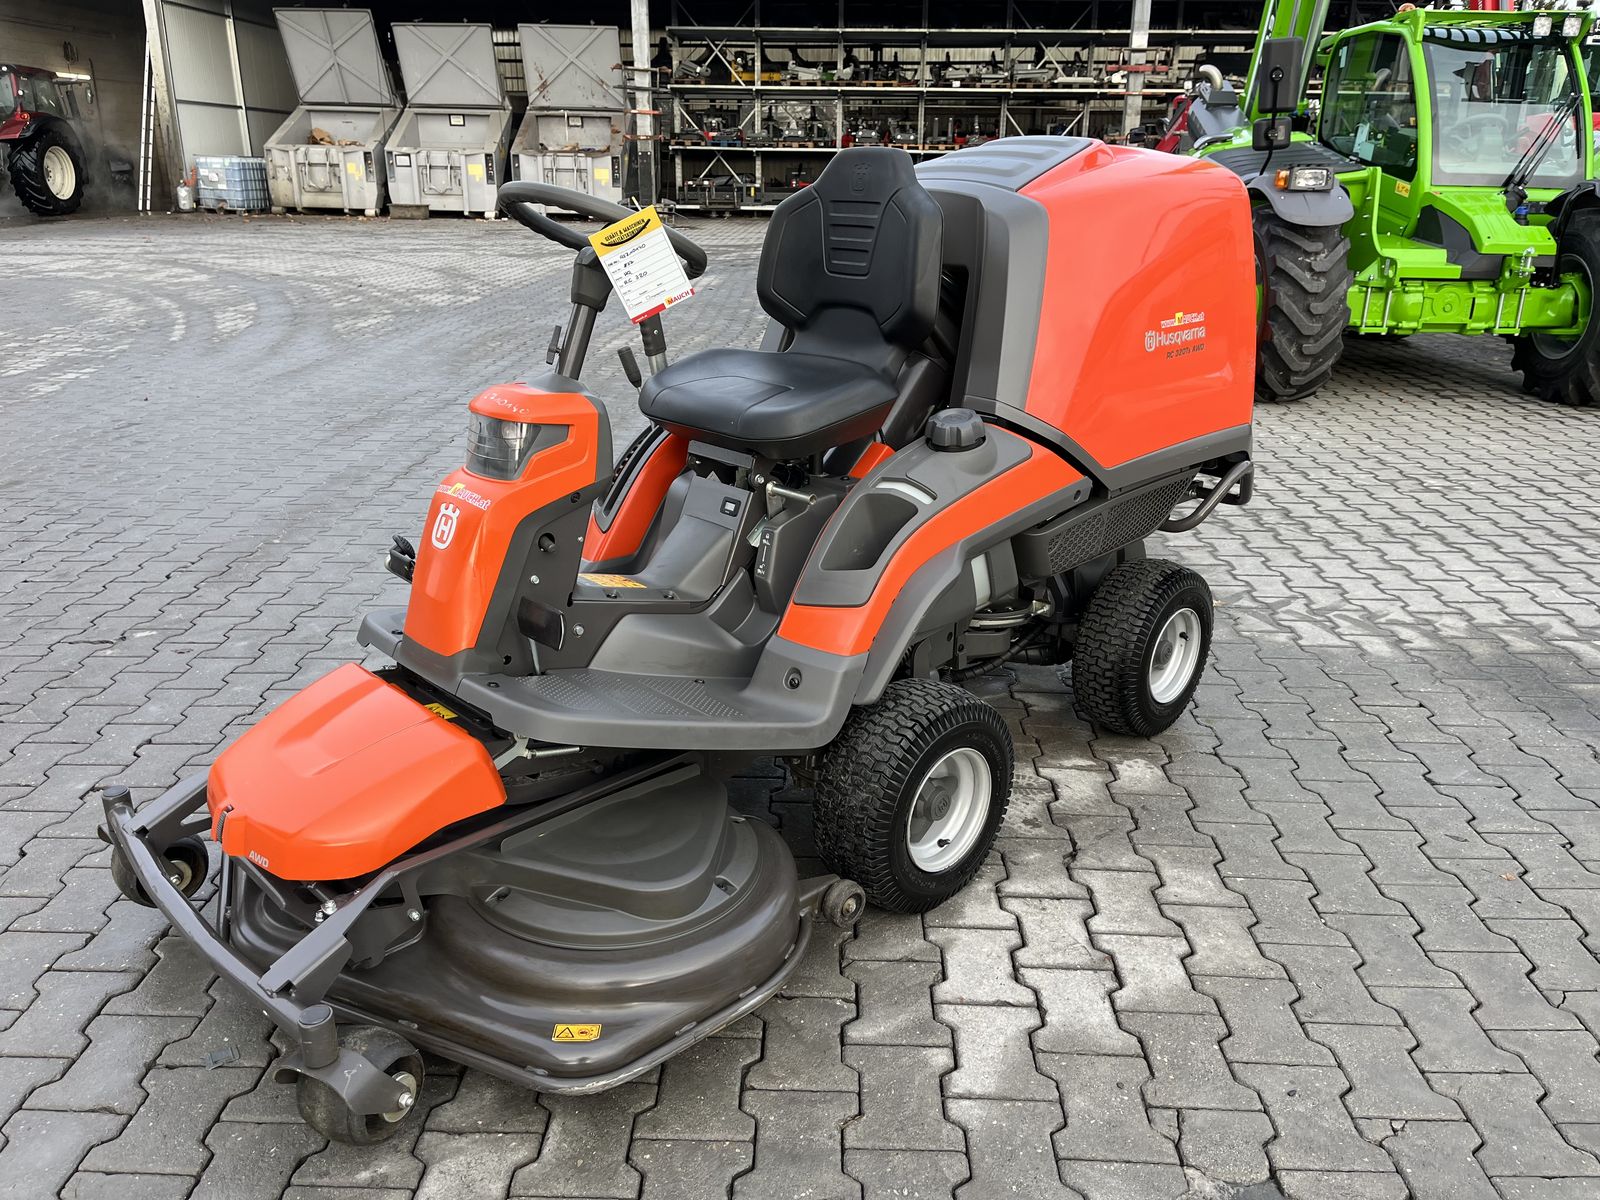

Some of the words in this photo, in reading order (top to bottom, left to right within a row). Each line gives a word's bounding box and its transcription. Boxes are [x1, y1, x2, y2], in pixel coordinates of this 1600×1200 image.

[623, 218, 646, 234] MASCHINEN
[635, 271, 648, 280] 320
[666, 290, 690, 305] MAUCH
[1156, 327, 1206, 347] Husqvarna
[1166, 350, 1175, 359] RC
[1192, 344, 1205, 353] AWD
[249, 850, 269, 868] AWD
